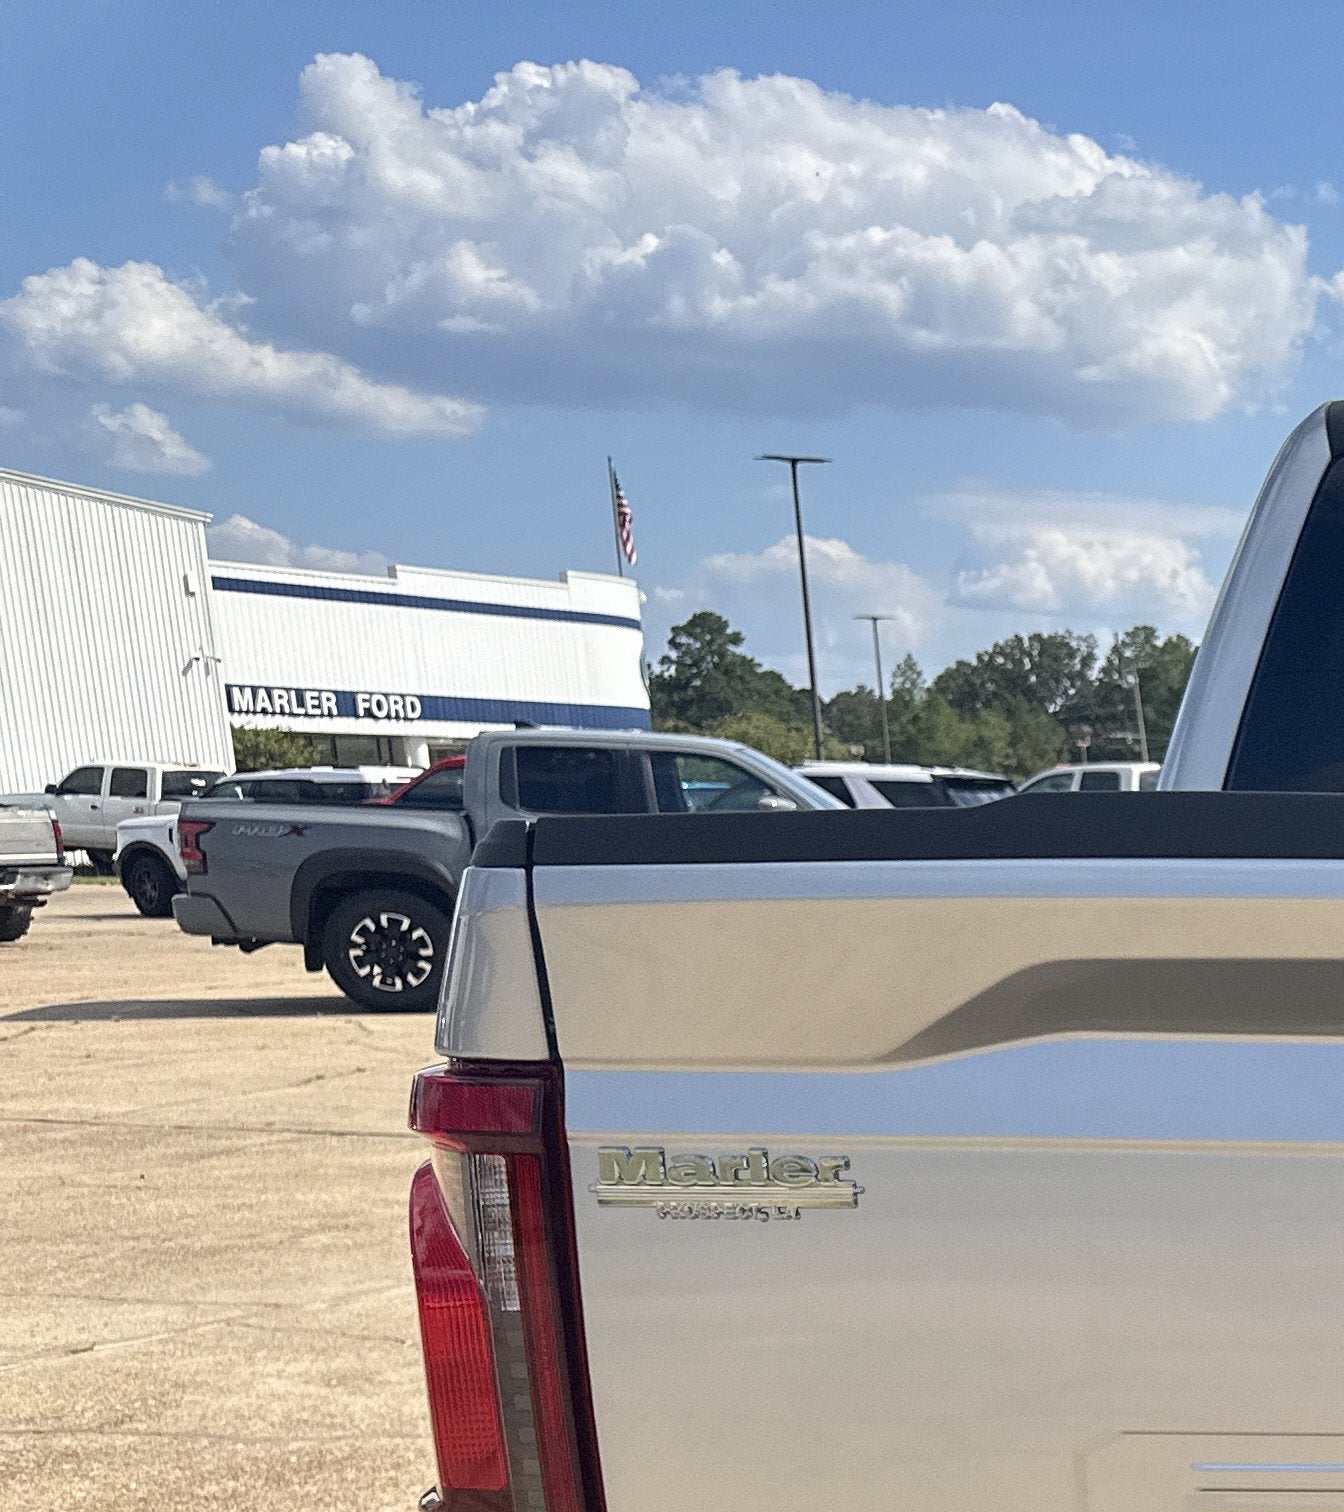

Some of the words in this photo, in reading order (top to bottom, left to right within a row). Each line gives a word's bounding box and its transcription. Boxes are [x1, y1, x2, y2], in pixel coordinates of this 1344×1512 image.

[232, 686, 338, 715] MARLER
[356, 693, 422, 719] FORD
[598, 1146, 853, 1186] Marler
